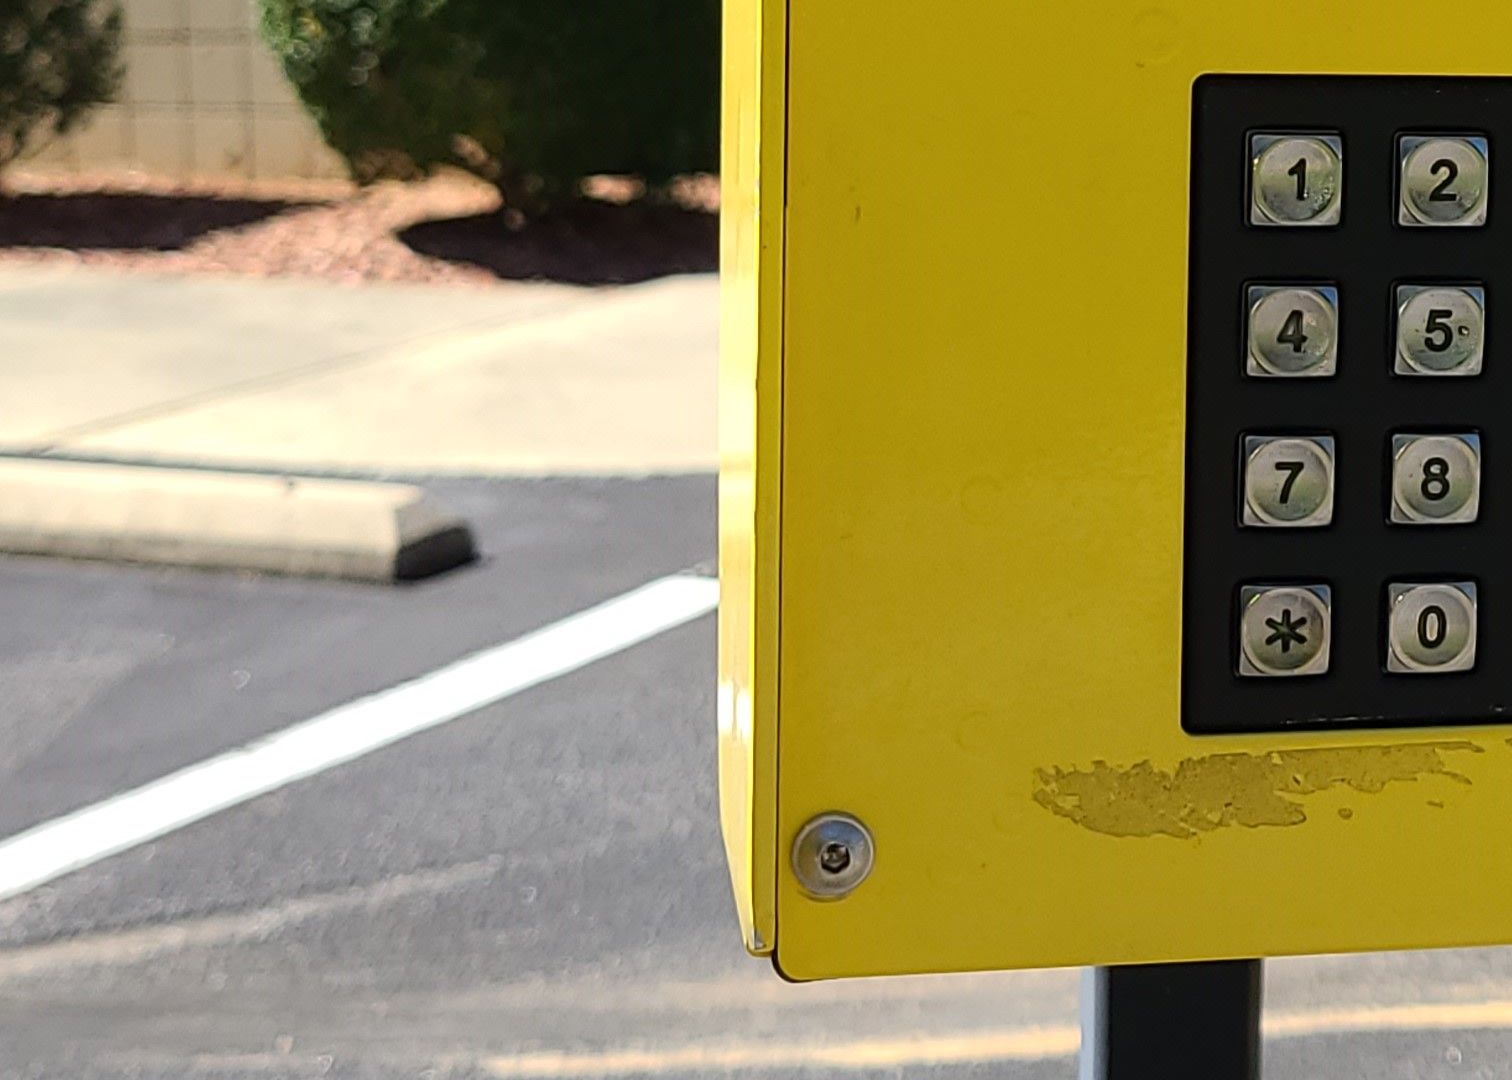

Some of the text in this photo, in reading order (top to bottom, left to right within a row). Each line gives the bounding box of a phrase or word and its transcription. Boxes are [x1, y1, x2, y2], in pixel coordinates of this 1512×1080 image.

[1287, 158, 1308, 201] 1
[1429, 158, 1459, 202] 2
[1276, 309, 1308, 353] 4
[1424, 309, 1454, 352] 5
[1274, 461, 1305, 504] 7
[1420, 457, 1450, 501] 8
[1417, 605, 1447, 649] 0
